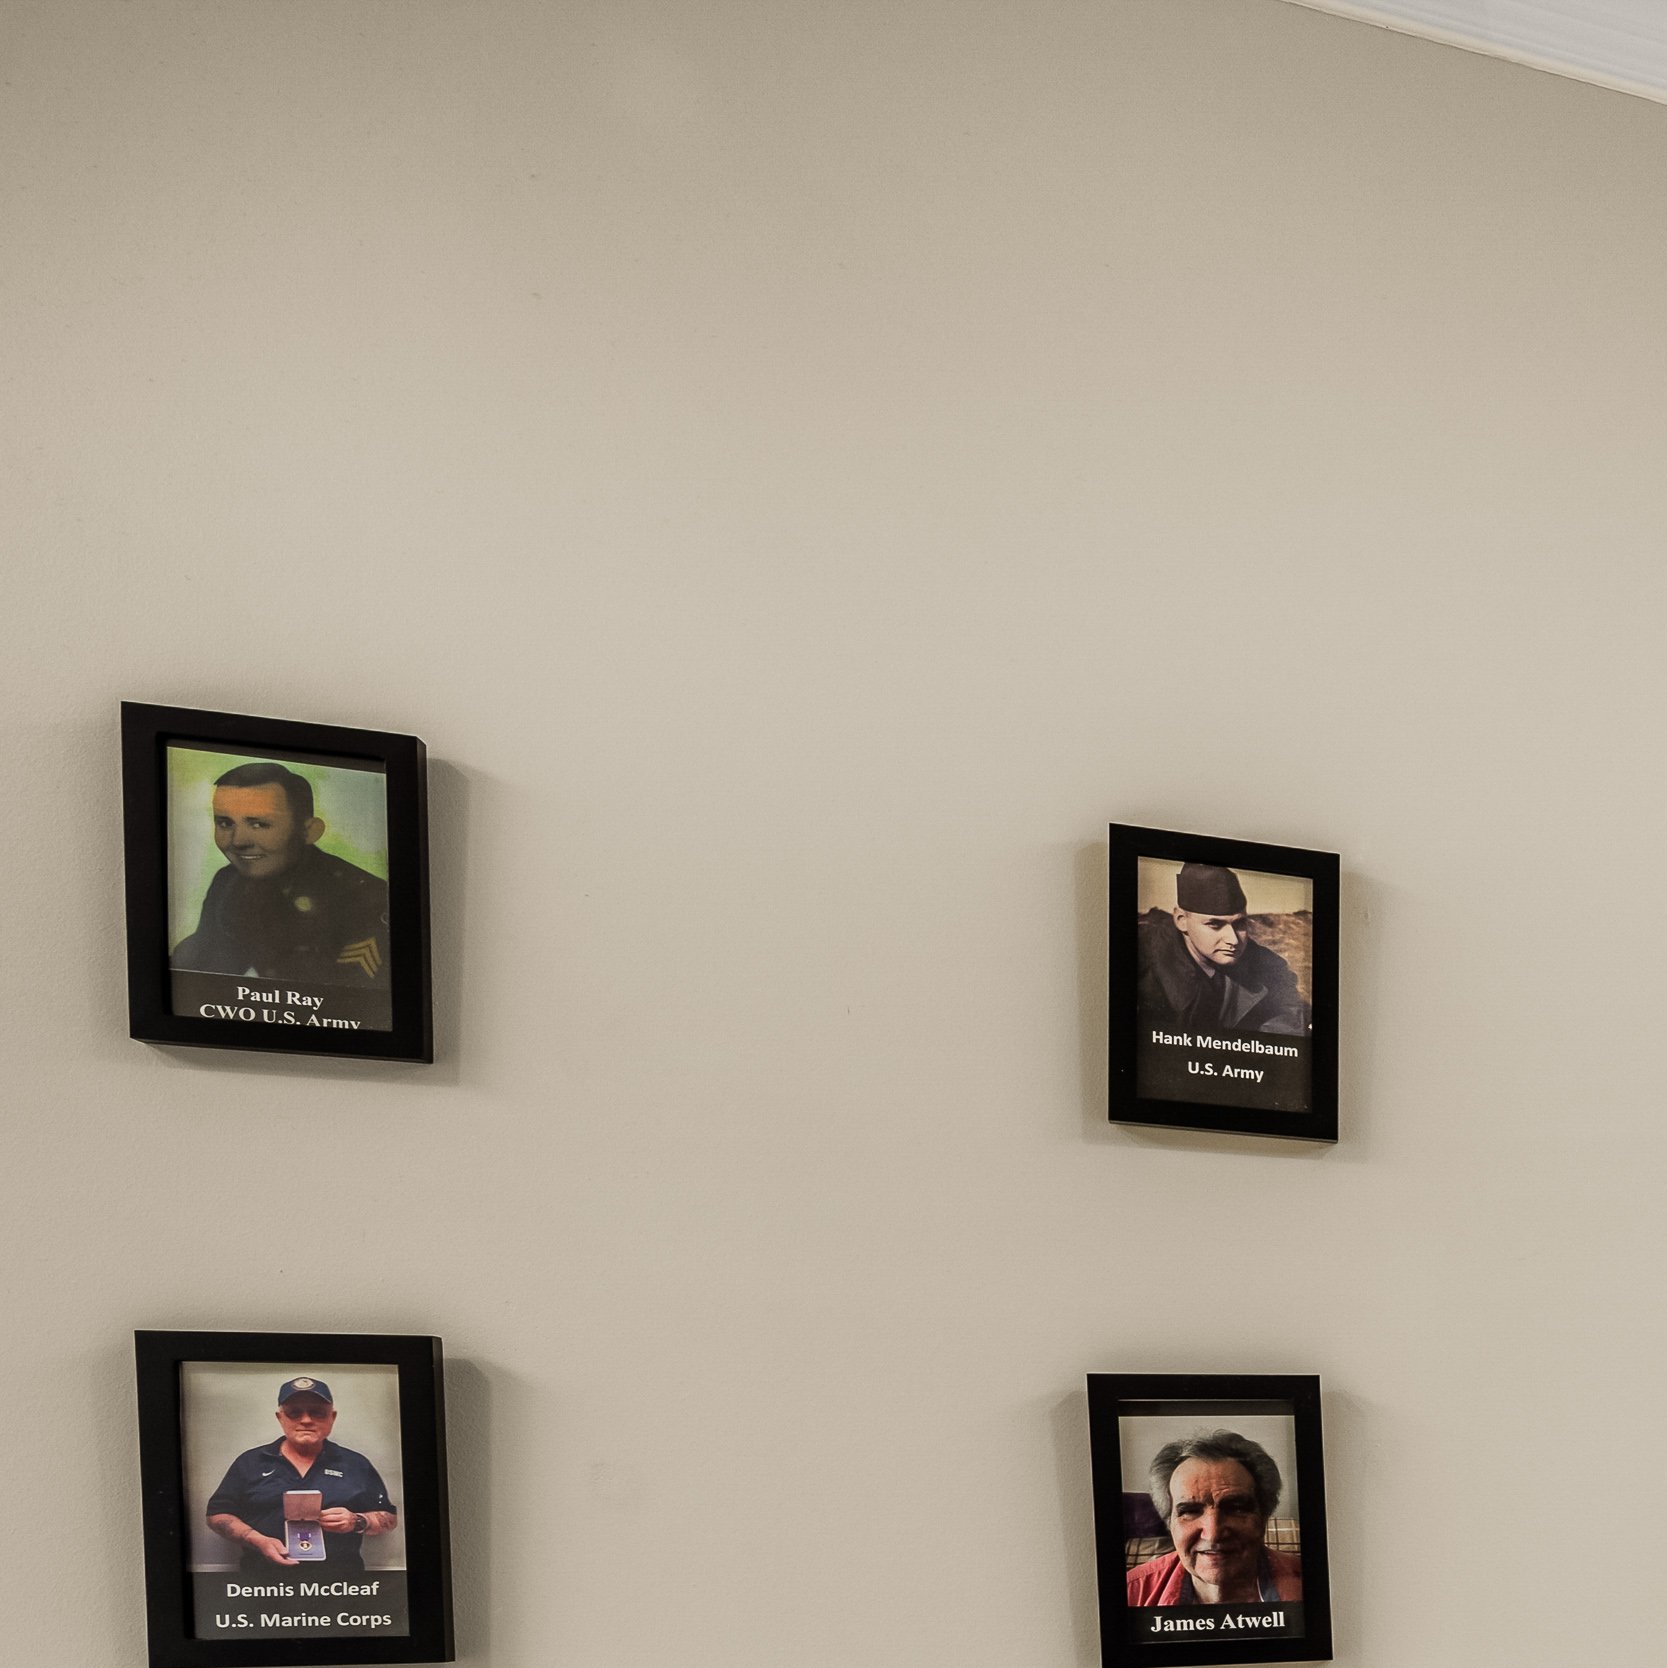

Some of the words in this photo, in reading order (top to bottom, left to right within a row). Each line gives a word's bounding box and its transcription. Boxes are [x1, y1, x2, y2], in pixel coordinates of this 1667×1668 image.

[237, 986, 280, 1004] Paul
[286, 991, 324, 1010] Ray
[200, 1004, 256, 1021] CWO
[262, 1009, 301, 1025] U.S.
[1152, 1030, 1193, 1047] Hank
[1196, 1035, 1299, 1058] Mendelbaum
[1187, 1061, 1218, 1076] U.S.
[1222, 1064, 1264, 1083] Army
[226, 1582, 294, 1598] Dennis
[300, 1581, 380, 1597] McCleaf
[215, 1613, 254, 1628] U.S.
[260, 1612, 331, 1628] Marine
[336, 1612, 392, 1628] Corps
[1150, 1615, 1215, 1633] James
[1220, 1611, 1286, 1630] Atwell
